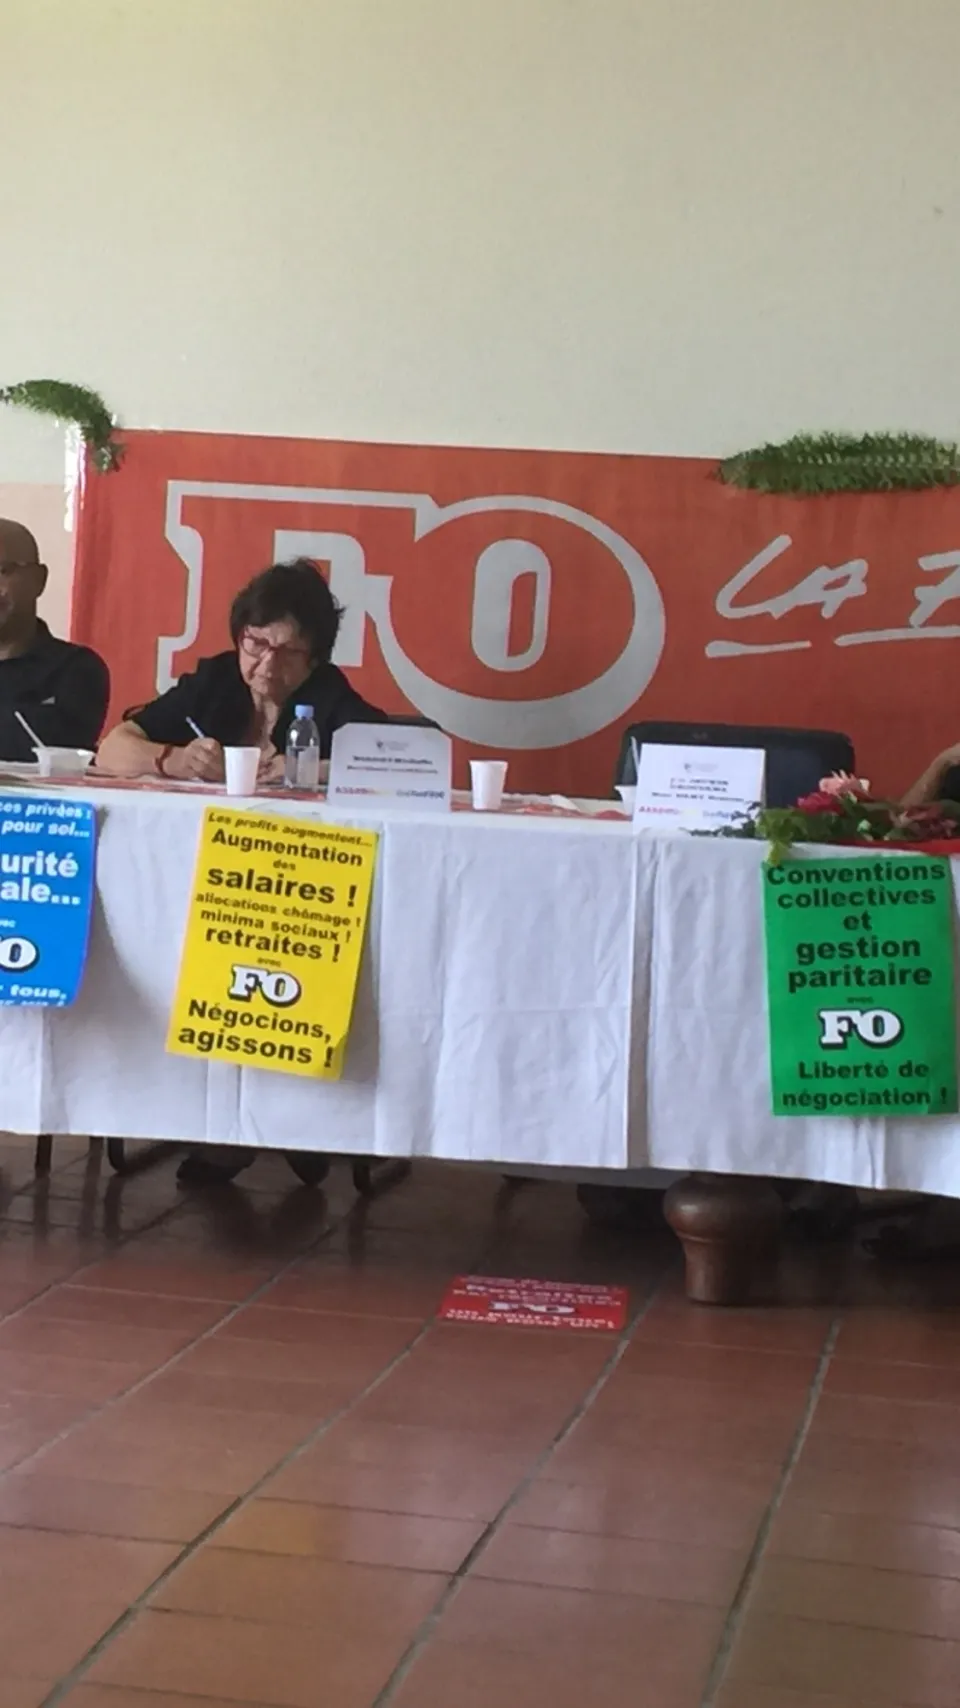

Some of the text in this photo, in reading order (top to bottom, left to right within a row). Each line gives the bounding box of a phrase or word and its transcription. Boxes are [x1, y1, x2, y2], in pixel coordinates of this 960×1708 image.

[156, 480, 666, 750] FO
[2, 820, 44, 835] pour
[208, 812, 231, 824] Les
[235, 816, 278, 832] profits
[211, 828, 363, 867] Augmentation
[273, 858, 296, 871] des
[767, 861, 946, 885] Conventions
[207, 867, 335, 904] salaires
[777, 885, 937, 909] collectives
[196, 892, 277, 914] allocations
[282, 906, 351, 927] chômage
[201, 909, 264, 929] minima
[271, 921, 339, 942] sociaux
[843, 911, 872, 931] et
[0, 936, 40, 973] O
[205, 927, 322, 960] retraites
[796, 935, 921, 966] gestion
[228, 963, 302, 1008] FO
[788, 963, 932, 994] paritaire
[188, 999, 331, 1044] Négocions,
[819, 1008, 904, 1049] FO
[178, 1027, 313, 1064] agissons
[798, 1060, 930, 1079] Liberté de
[782, 1088, 931, 1110] négociation
